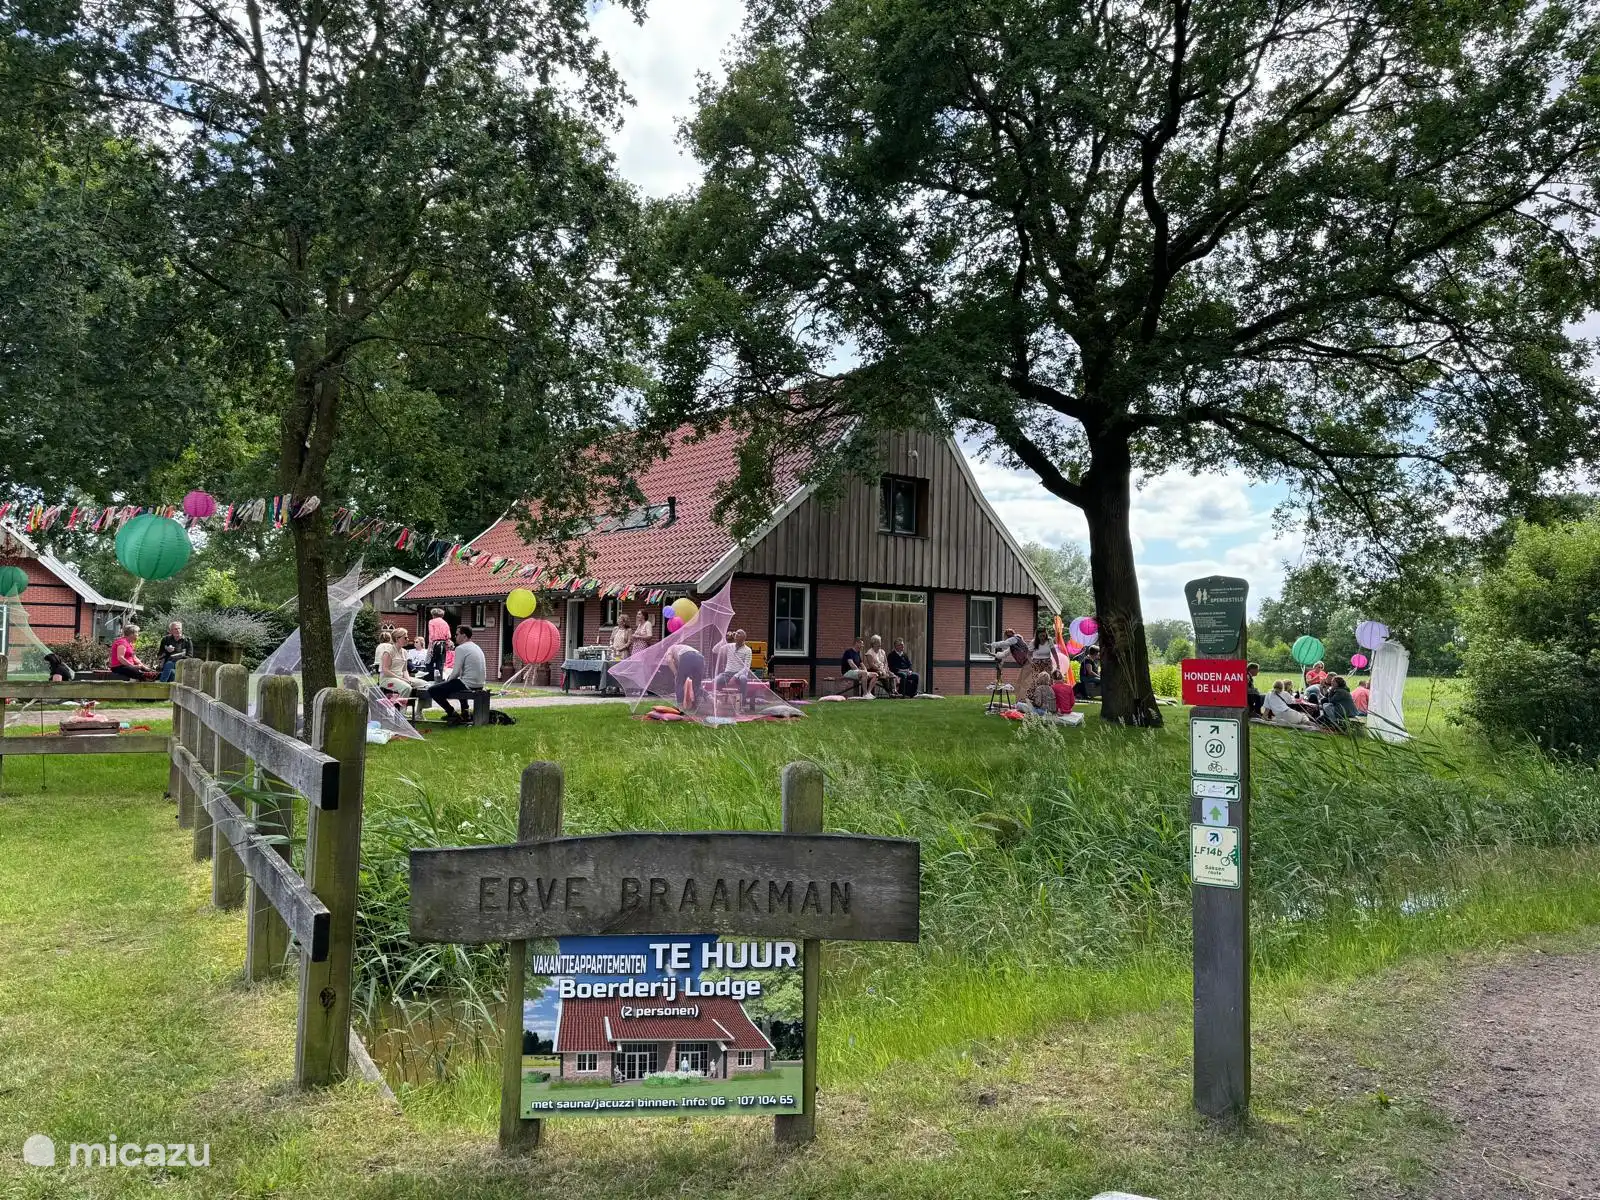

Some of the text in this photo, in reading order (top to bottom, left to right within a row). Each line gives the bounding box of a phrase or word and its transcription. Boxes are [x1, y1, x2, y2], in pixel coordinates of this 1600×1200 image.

[1184, 672, 1244, 682] HONDEN AAN
[1197, 684, 1231, 693] DE LIJN
[1208, 743, 1223, 754] 20
[1194, 845, 1222, 857] LF14b
[478, 876, 853, 915] ERVE BRAAKMAN
[532, 941, 797, 975] VAKANTIEAPPARTEMENTEN TE HUUR
[558, 976, 761, 1001] Boerderij Lodge
[620, 1005, 699, 1019] (2 personen)
[531, 1098, 553, 1109] met
[556, 1098, 635, 1110] sauna/jacuzzi
[637, 1097, 678, 1108] binnen.
[681, 1096, 708, 1107] Info:
[711, 1096, 725, 1106] 06
[736, 1096, 754, 1106] 107
[757, 1095, 777, 1105] 104
[780, 1095, 794, 1105] 65
